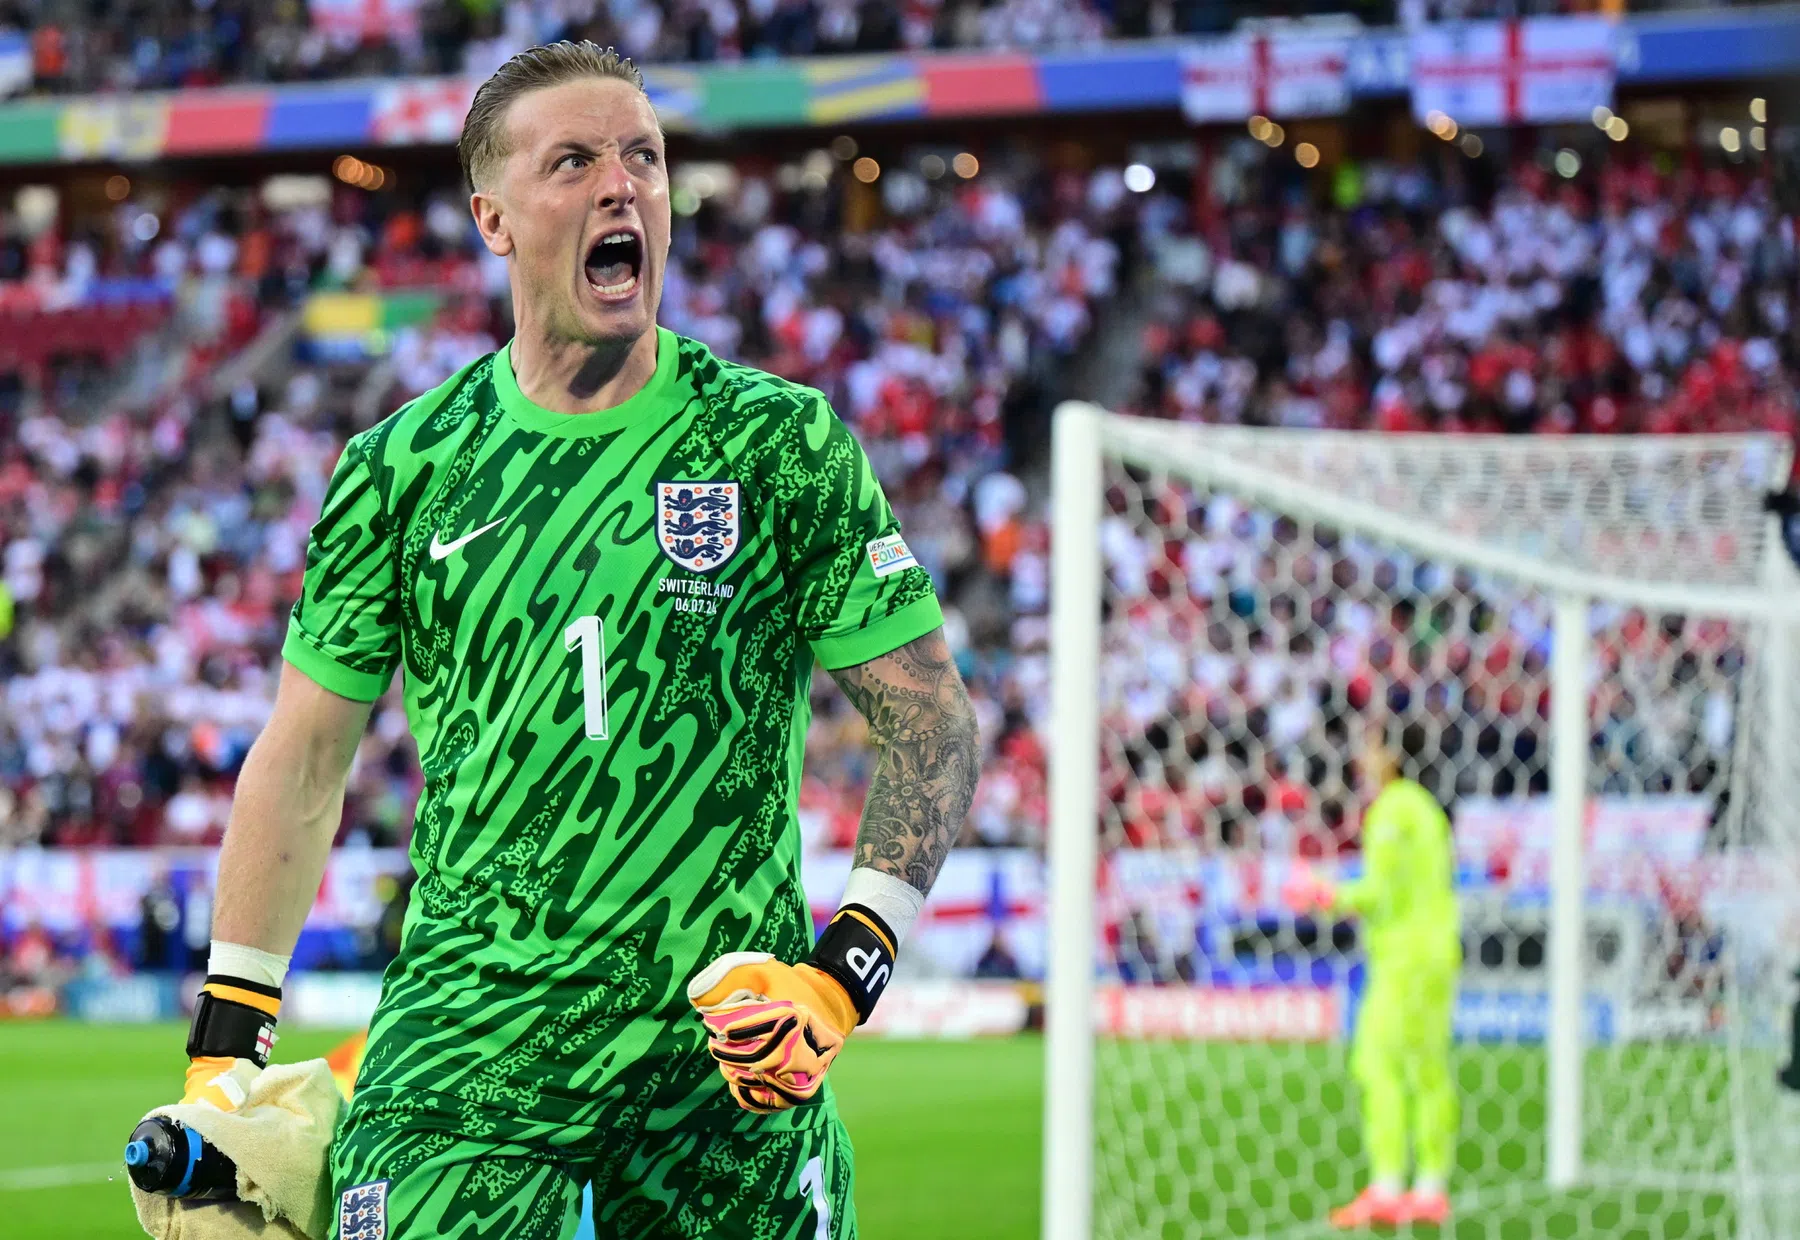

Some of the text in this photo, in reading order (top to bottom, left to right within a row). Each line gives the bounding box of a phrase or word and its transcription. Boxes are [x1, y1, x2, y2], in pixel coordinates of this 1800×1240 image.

[869, 541, 886, 552] UEFA
[658, 578, 734, 598] SWITZERLAND
[675, 598, 718, 614] 06.07.24
[564, 615, 609, 741] 1
[845, 946, 890, 994] JP
[798, 1155, 831, 1240] 1
